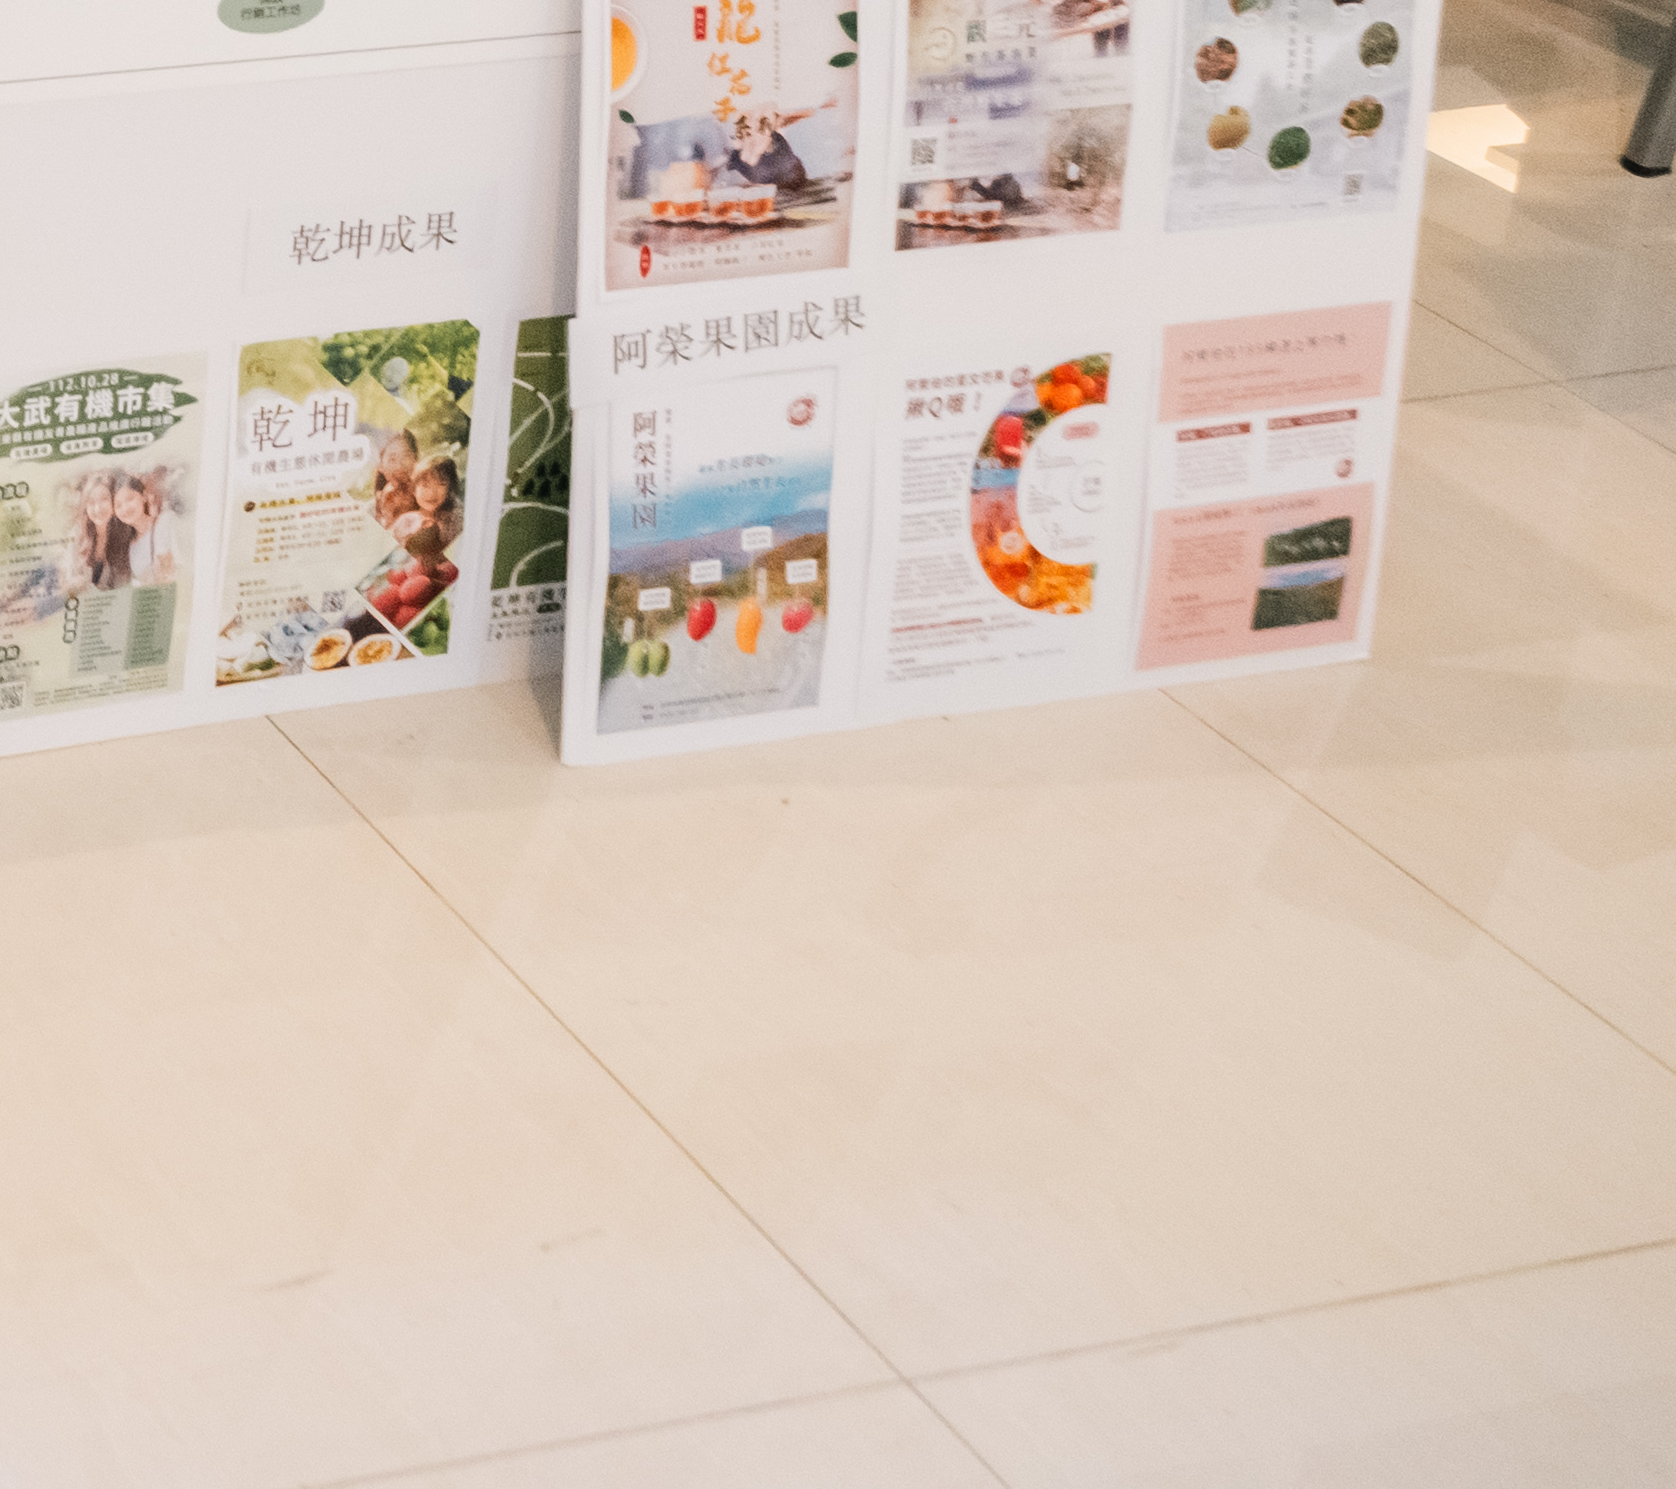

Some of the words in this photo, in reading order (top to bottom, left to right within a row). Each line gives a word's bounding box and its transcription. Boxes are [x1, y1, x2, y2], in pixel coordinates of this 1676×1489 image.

[289, 209, 459, 266] 乾坤成果
[612, 294, 868, 377] 阿榮果園成果
